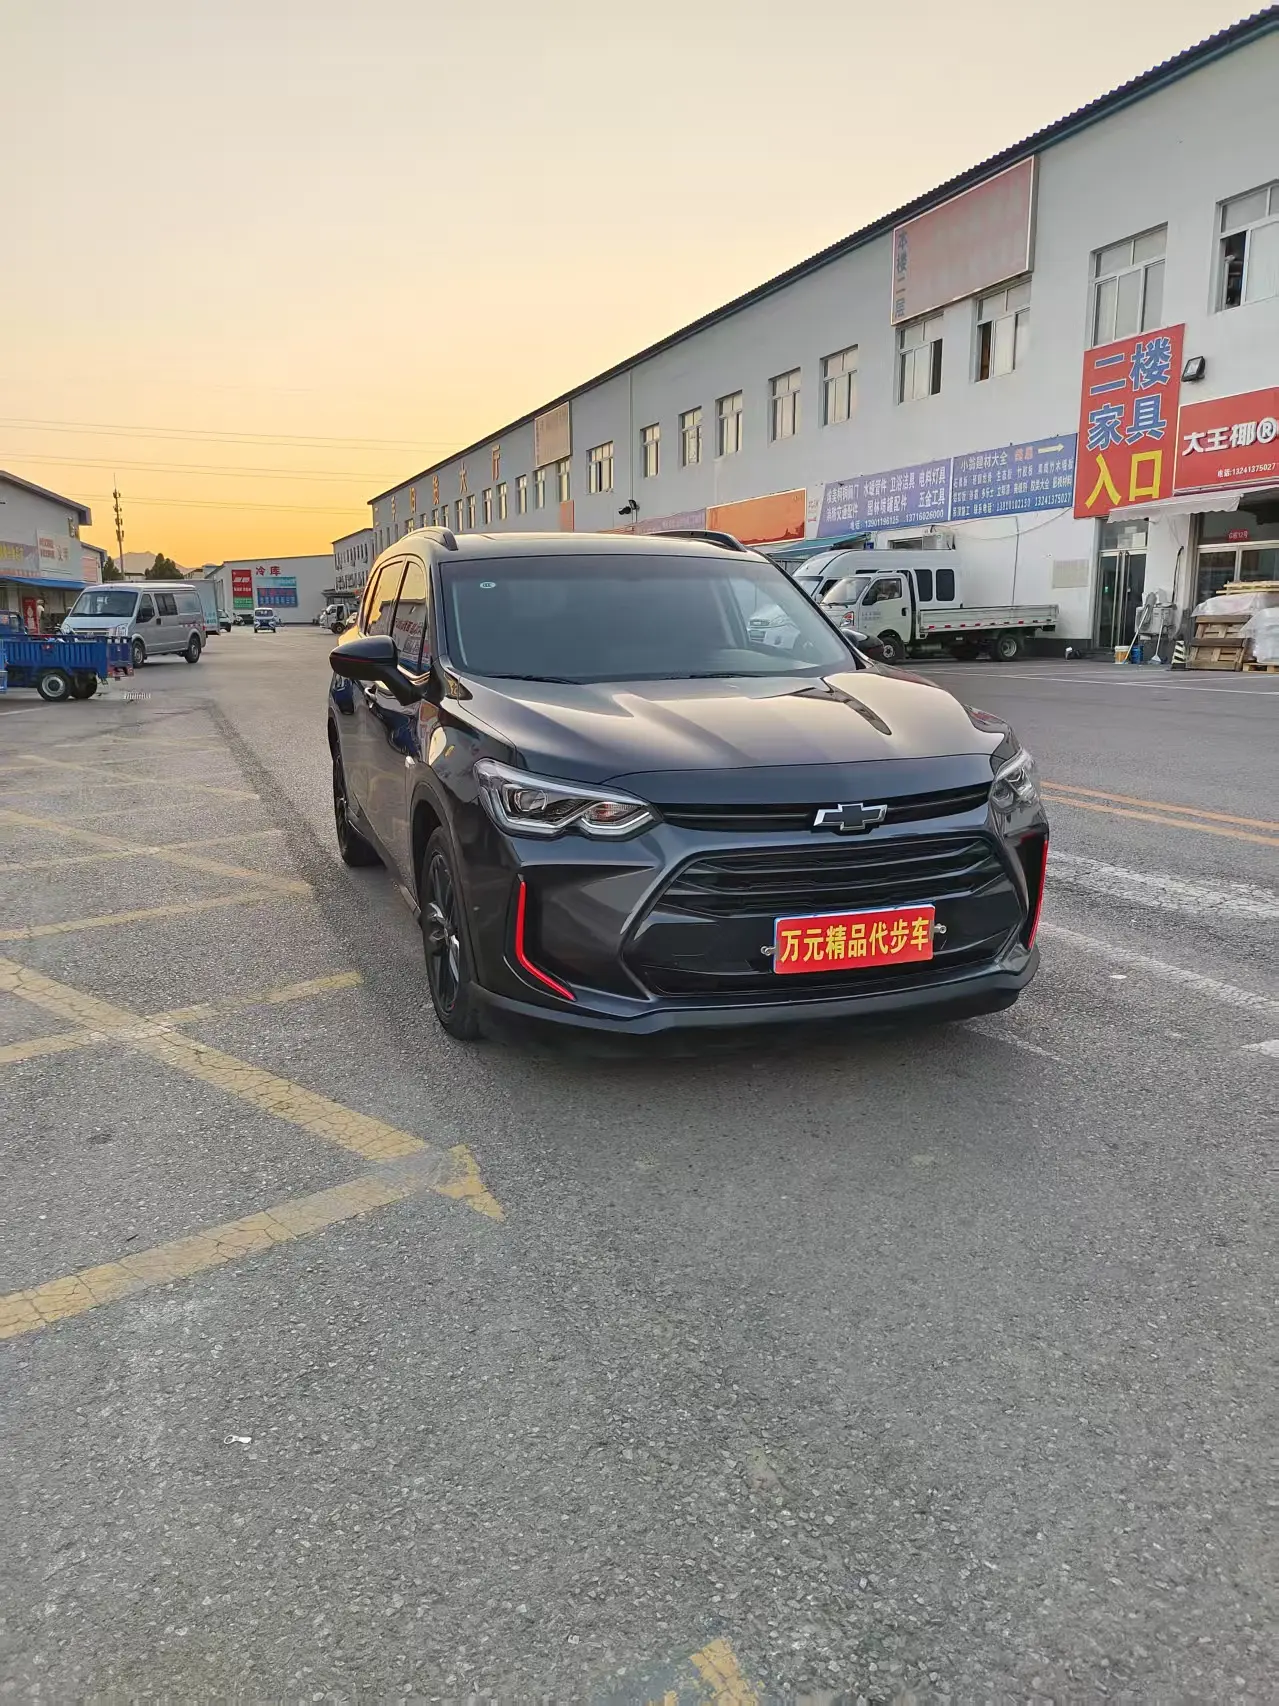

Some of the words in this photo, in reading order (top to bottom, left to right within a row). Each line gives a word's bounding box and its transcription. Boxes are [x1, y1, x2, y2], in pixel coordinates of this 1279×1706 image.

[1089, 336, 1173, 396] 二楼
[1085, 393, 1167, 452] 家具
[918, 488, 945, 508] 五金工具
[1085, 449, 1163, 508] 入口
[255, 566, 282, 576] 冷库
[780, 916, 929, 964] 万元精品代步车
